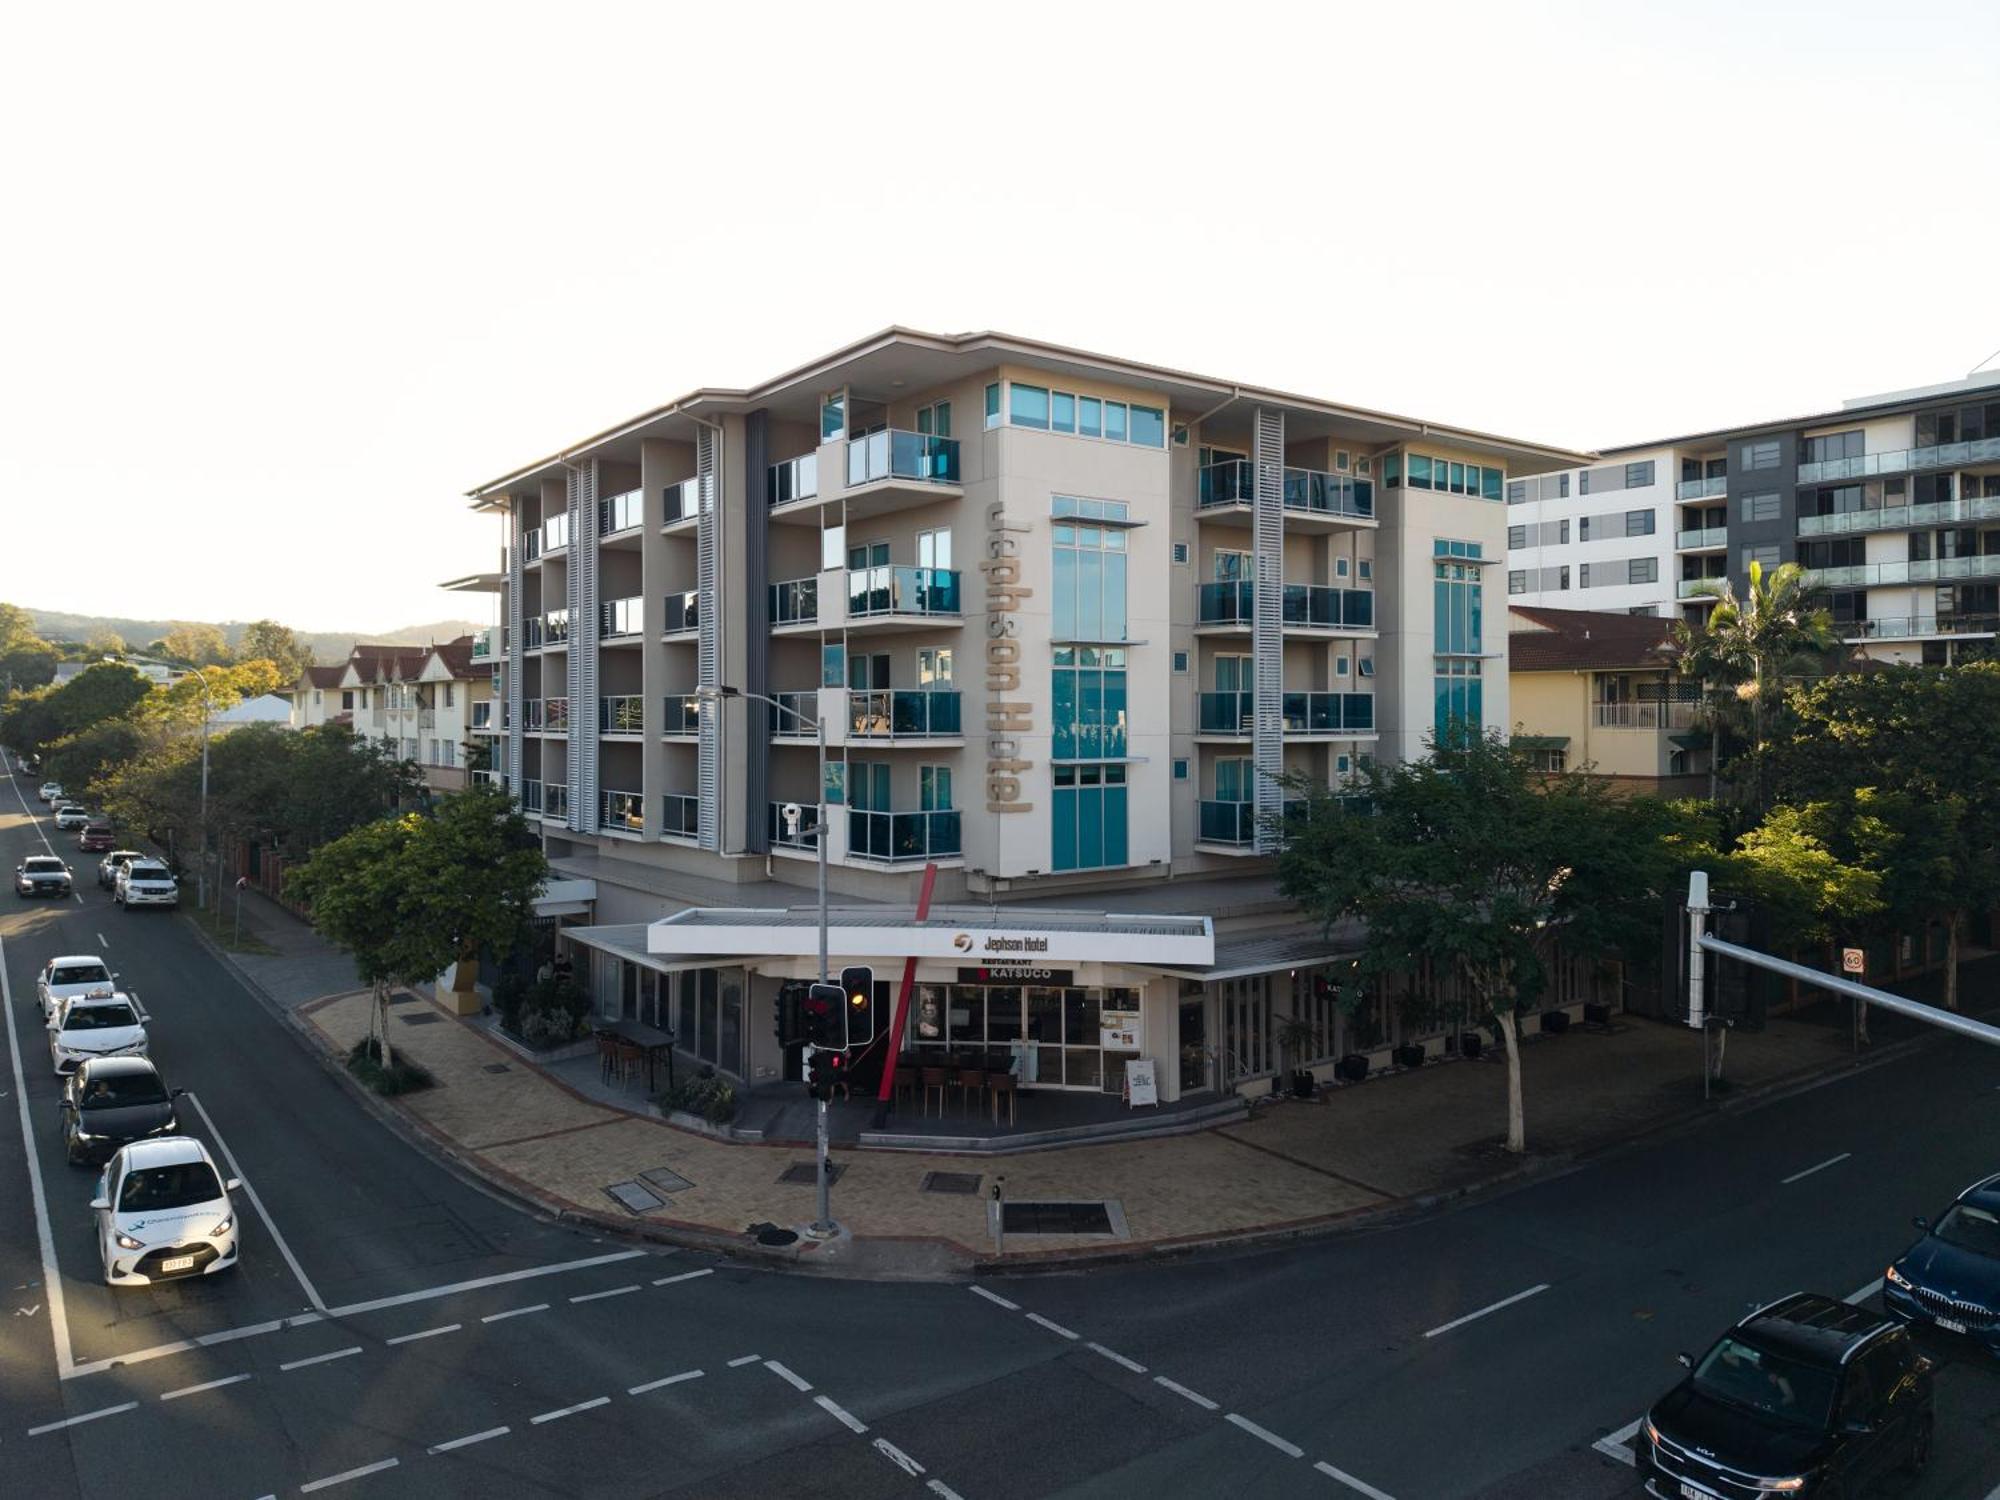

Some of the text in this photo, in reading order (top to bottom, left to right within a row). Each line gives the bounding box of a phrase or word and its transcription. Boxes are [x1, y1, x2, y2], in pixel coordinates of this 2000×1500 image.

[979, 502, 1033, 812] Jephson Hotel
[985, 936, 1047, 953] Jephson Hotel
[1847, 956, 1859, 965] 60
[990, 968, 1052, 979] KATSUCO
